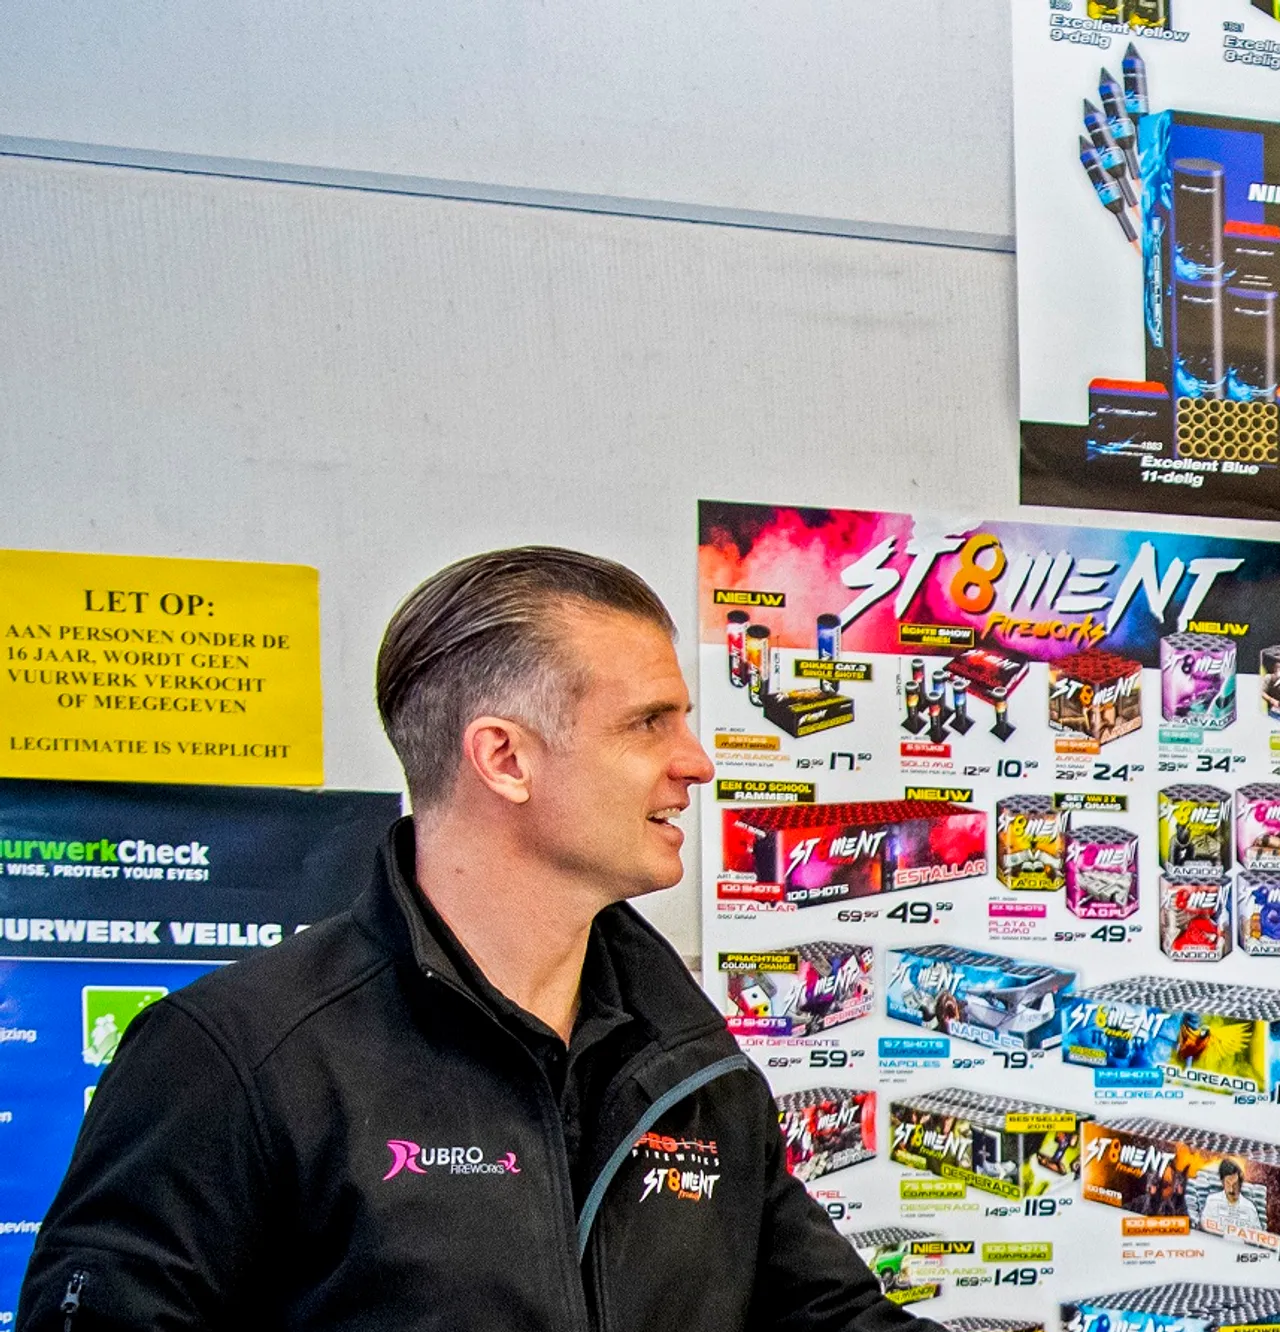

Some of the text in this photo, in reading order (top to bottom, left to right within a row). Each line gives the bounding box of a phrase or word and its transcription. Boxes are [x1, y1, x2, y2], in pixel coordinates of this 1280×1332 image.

[1050, 14, 1189, 42] Excellent Yellow
[1141, 455, 1260, 477] Excellent Blue
[84, 589, 215, 617] LET OP:
[715, 591, 784, 606] NIEUW
[5, 623, 290, 650] AAN PERSONEN ONDER DE
[1189, 620, 1250, 636] NIEUW
[7, 646, 250, 670] 16 JAAR, WORDT GEEN
[7, 668, 267, 693] VUURWERK VERKOCHT
[57, 692, 247, 714] OF MEEGEGEVEN
[9, 736, 292, 759] LEGITIMATIE IS VERPLICHT
[907, 787, 972, 803] NIEUW
[7, 863, 209, 882] WISE, PROTECT YOUR EYES!
[896, 859, 988, 886] ESTALLAR
[745, 884, 781, 895] SHOTS
[810, 883, 849, 897] SHOTS
[170, 922, 283, 948] VEILIG
[904, 1040, 944, 1049] SHOTS
[449, 1162, 505, 1176] FIREWORKS
[914, 1242, 974, 1255] NIEUW
